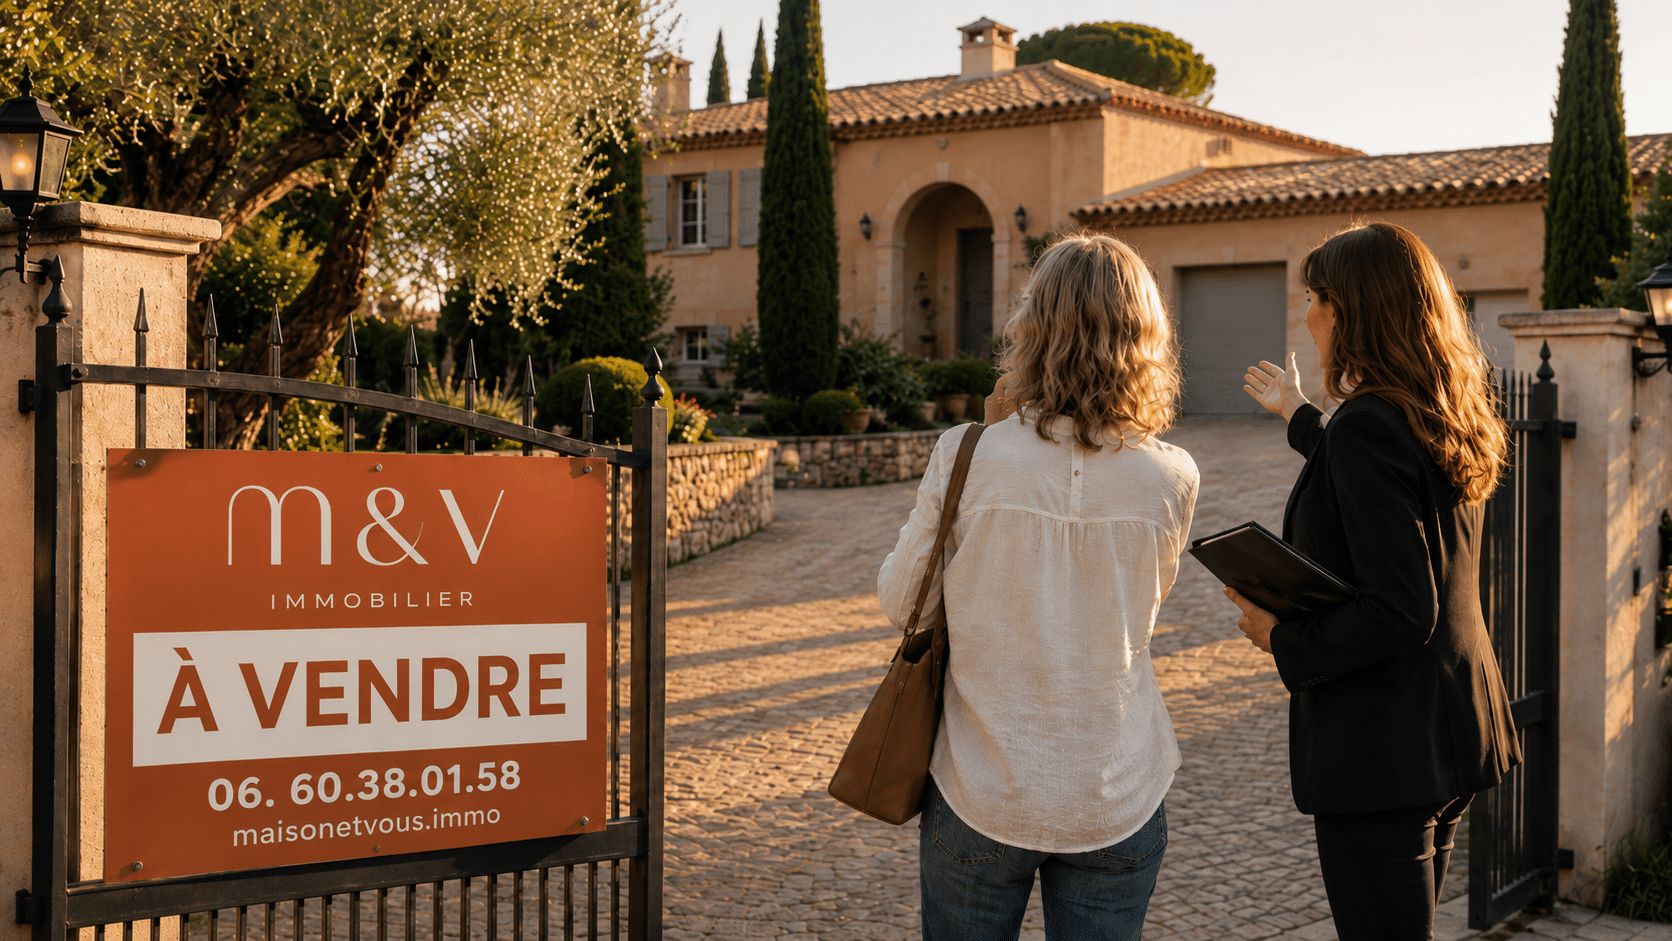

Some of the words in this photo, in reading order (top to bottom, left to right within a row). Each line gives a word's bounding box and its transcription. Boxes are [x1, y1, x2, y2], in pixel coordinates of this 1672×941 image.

[356, 487, 429, 566] &
[438, 489, 505, 565] V
[271, 591, 473, 610] IMMOBILIER
[157, 647, 219, 735] À
[238, 652, 566, 730] VENDRE
[208, 776, 275, 810] 06.
[290, 760, 521, 805] 60.38.01.58
[233, 808, 501, 847] maisonetvous.immo
